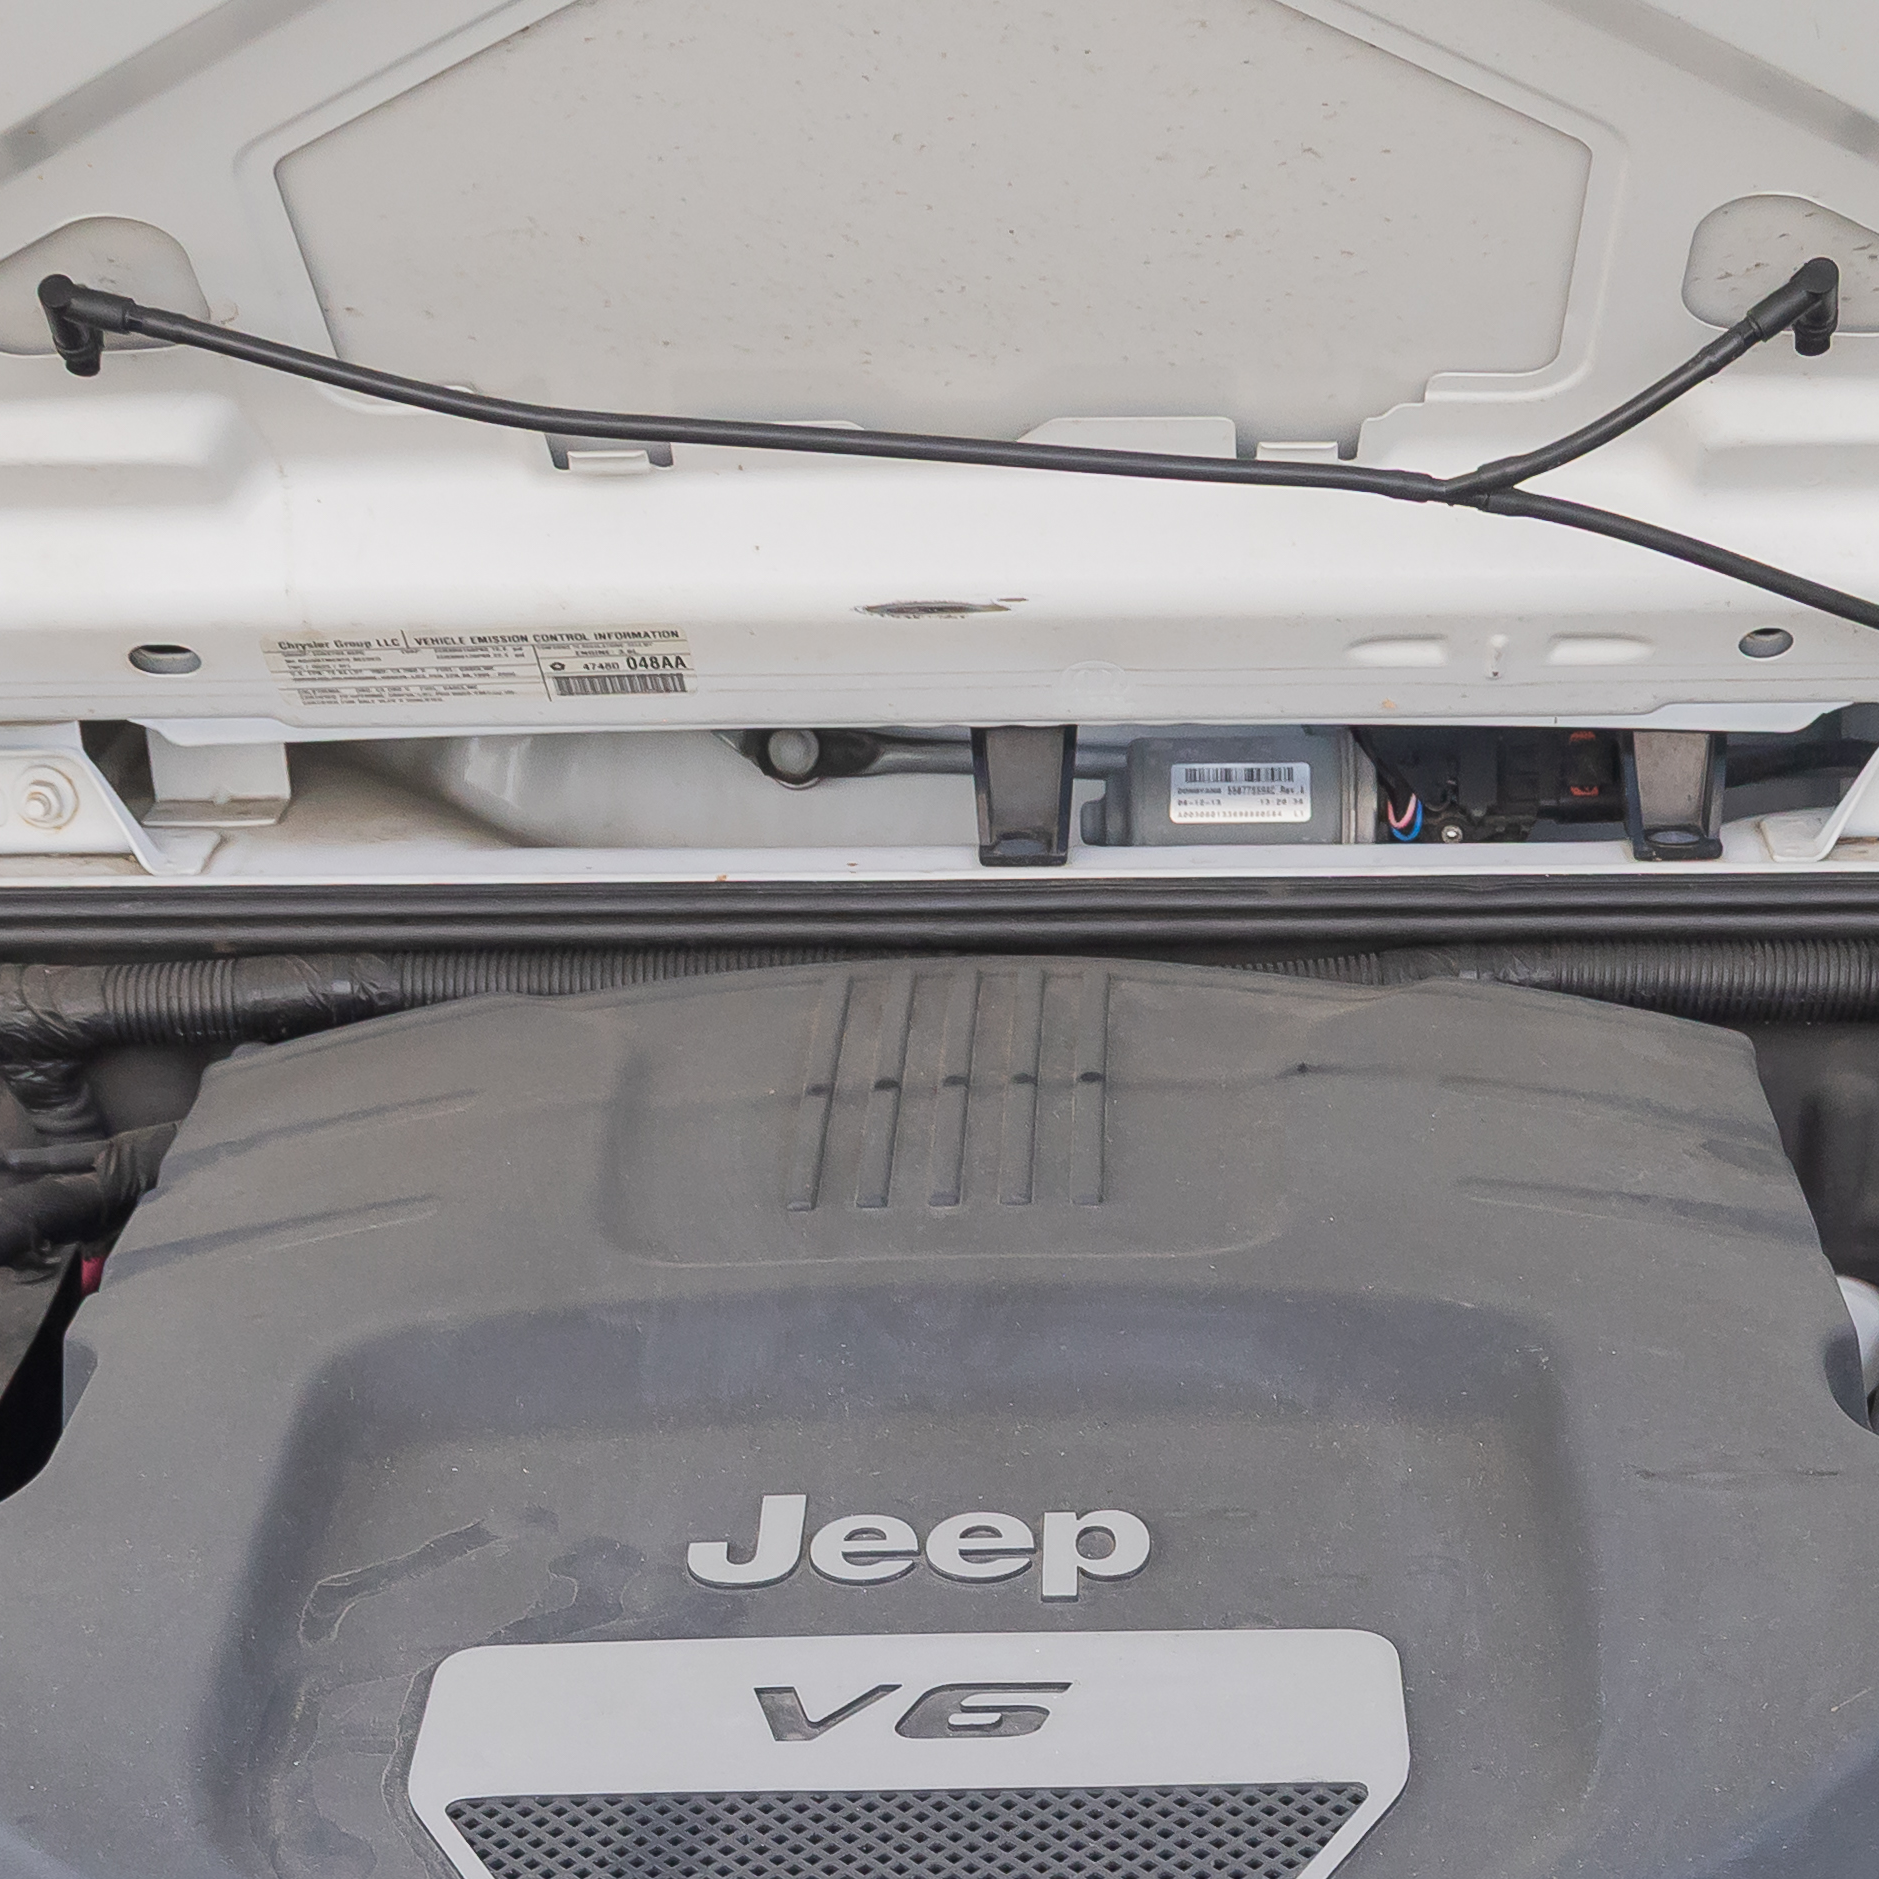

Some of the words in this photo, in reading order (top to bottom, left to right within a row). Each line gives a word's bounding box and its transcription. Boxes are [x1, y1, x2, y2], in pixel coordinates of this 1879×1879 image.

[277, 640, 330, 652] Chrysler
[334, 639, 371, 649] Group
[376, 638, 400, 647] LLC
[414, 635, 465, 645] VEHICLE
[471, 633, 528, 645] EMISSION
[533, 632, 589, 642] CONTROL
[594, 629, 680, 641] INFORMATION
[626, 656, 688, 671] 048AA
[686, 1493, 1153, 1602] Jeep
[753, 1681, 1072, 1742] V6
